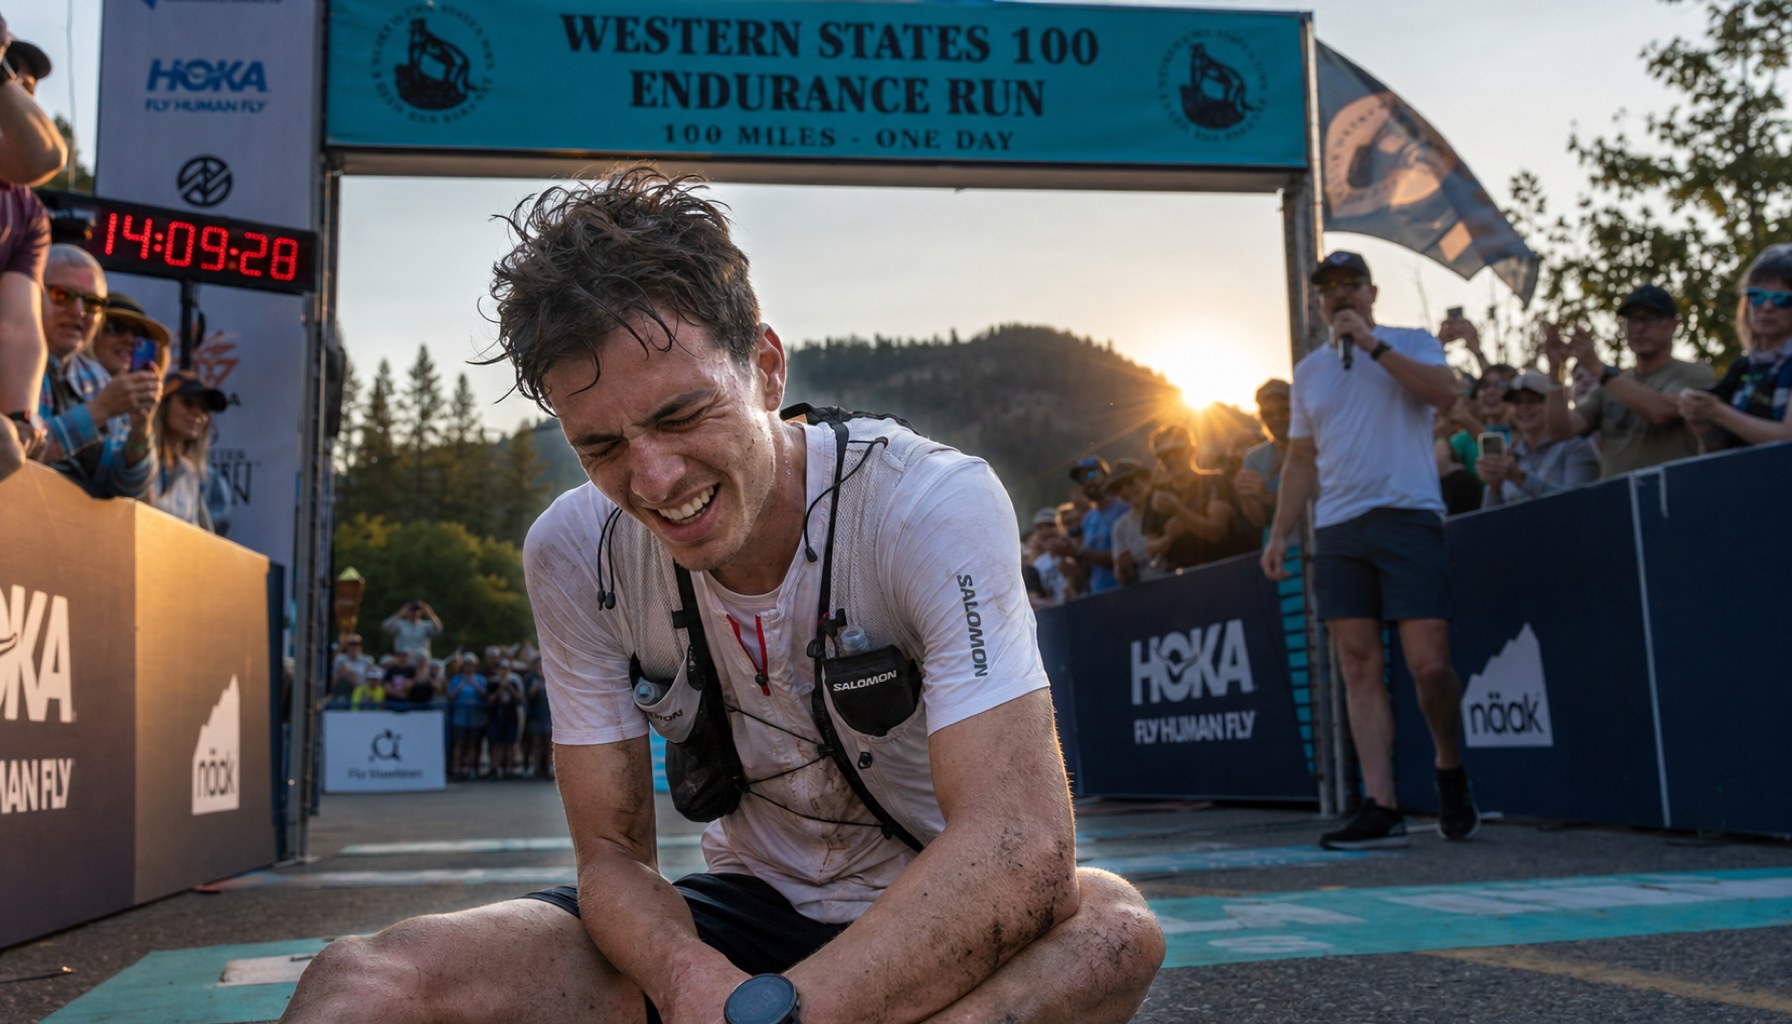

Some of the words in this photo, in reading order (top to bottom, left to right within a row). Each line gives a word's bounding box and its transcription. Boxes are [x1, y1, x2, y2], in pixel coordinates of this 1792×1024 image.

[560, 14, 801, 58] WESTERN
[818, 21, 990, 63] STATES
[1012, 27, 1098, 66] 100
[147, 58, 268, 92] HOKA
[629, 70, 929, 115] ENDURANCE
[947, 78, 1045, 117] RUN
[145, 98, 171, 112] FLY
[174, 98, 237, 112] HUMAN
[240, 99, 267, 113] FLY
[663, 124, 722, 146] 100
[738, 126, 836, 148] MILES
[876, 129, 940, 149] ONE
[956, 130, 1014, 151] DAY
[104, 212, 298, 281] 14:09:28
[957, 574, 988, 677] SALOMON
[833, 670, 897, 692] SALOMON
[1130, 618, 1254, 706] HOKA
[1134, 717, 1159, 744] FLY
[1160, 713, 1224, 743] HUMAN
[1225, 710, 1256, 740] FLY
[1470, 691, 1545, 735] näak
[0, 759, 38, 815] AN
[40, 757, 73, 811] FLY
